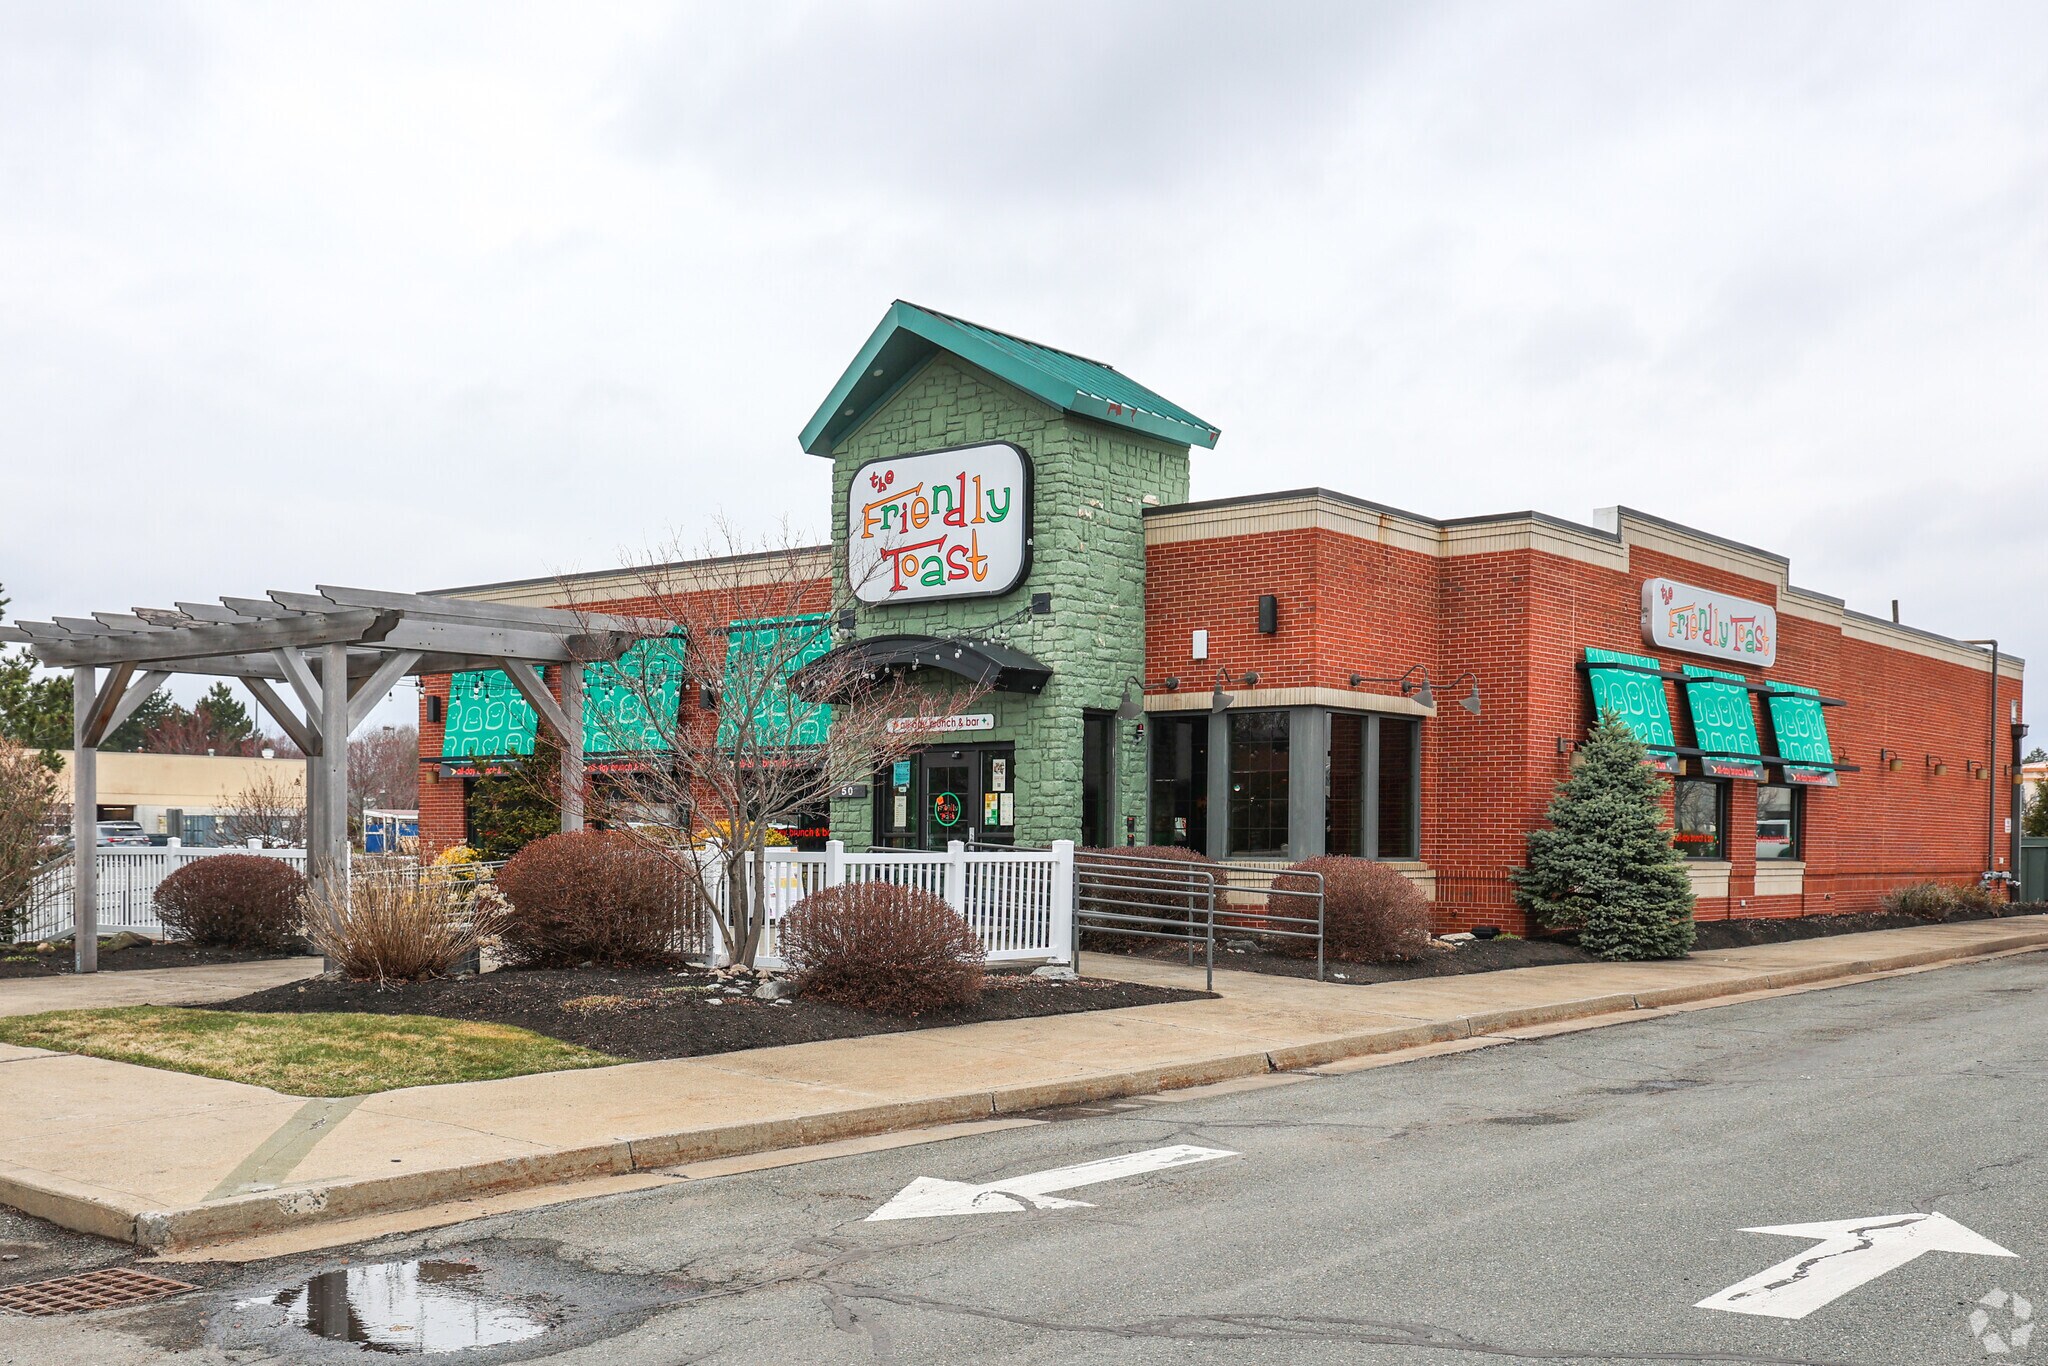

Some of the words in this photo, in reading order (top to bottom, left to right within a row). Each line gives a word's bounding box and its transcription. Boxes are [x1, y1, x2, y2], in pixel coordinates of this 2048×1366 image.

[869, 469, 895, 494] the
[861, 471, 1011, 539] Friendly
[880, 528, 989, 592] Toast
[1661, 584, 1673, 606] the
[1668, 602, 1729, 649] Friendly
[1730, 614, 1770, 656] Toast
[958, 717, 964, 727] &
[966, 716, 980, 727] bar
[841, 786, 854, 796] 50
[789, 827, 814, 837] brunch
[815, 827, 820, 838] &
[822, 827, 831, 837] ba
